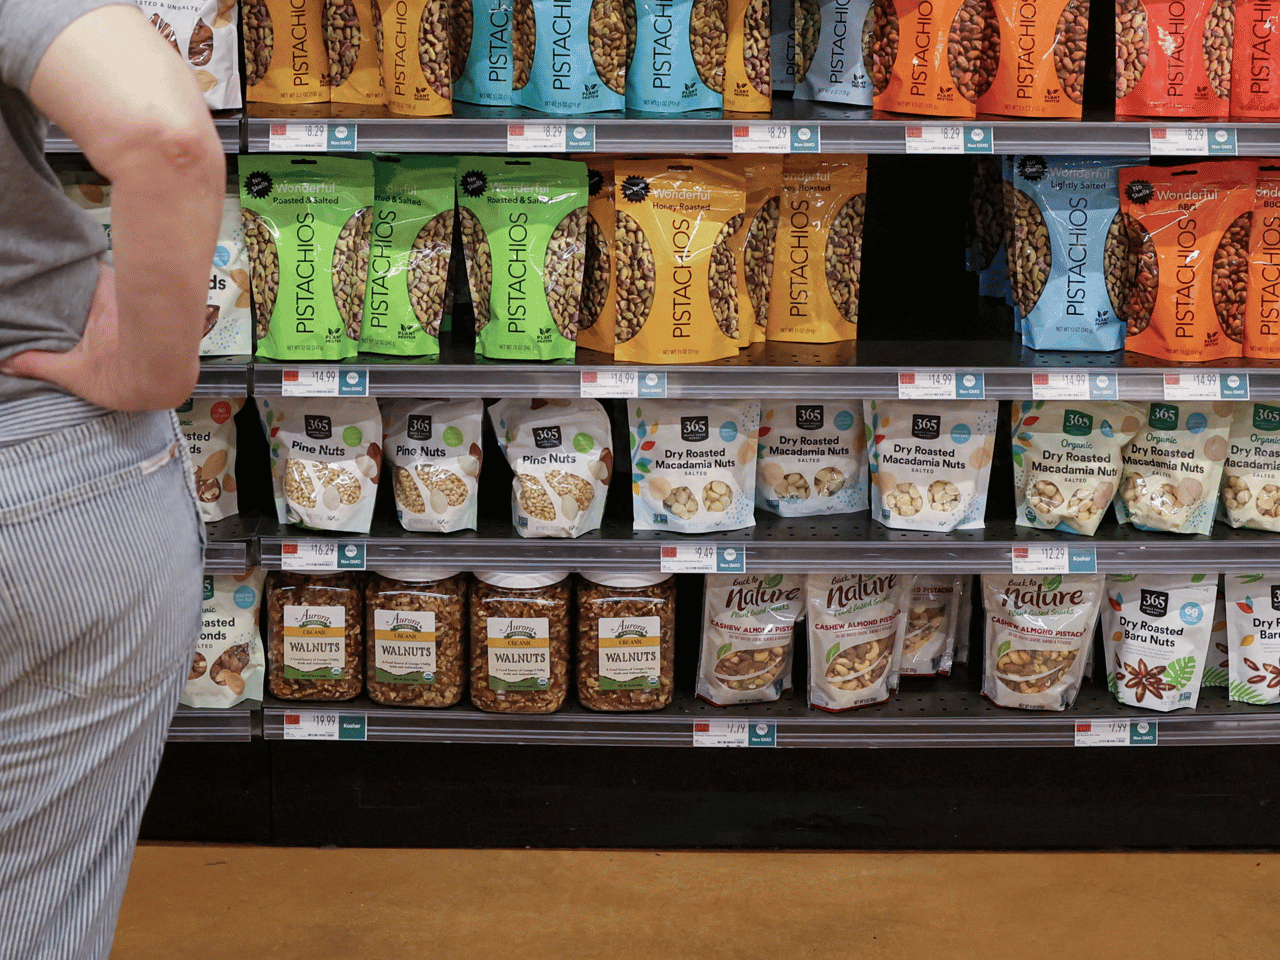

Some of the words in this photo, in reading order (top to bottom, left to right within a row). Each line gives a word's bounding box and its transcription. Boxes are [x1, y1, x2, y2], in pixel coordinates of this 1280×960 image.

[305, 125, 323, 136] $8.29
[1051, 181, 1078, 190] Lightly
[296, 213, 314, 332] PISTACHIOS
[292, 441, 316, 453] Pine
[319, 445, 344, 456] Nuts
[665, 450, 683, 460] Dry
[686, 448, 725, 458] Roasted
[656, 460, 711, 469] Macadamia
[311, 544, 334, 555] $16.29
[1041, 547, 1064, 559] $12.29
[1001, 584, 1084, 608] nature
[295, 609, 331, 622] Aurora
[991, 616, 1019, 630] CASHEW
[1021, 627, 1053, 636] ALMOND
[1253, 618, 1273, 629] Dry
[290, 642, 340, 652] WALNUTS
[312, 716, 335, 727] $19.99
